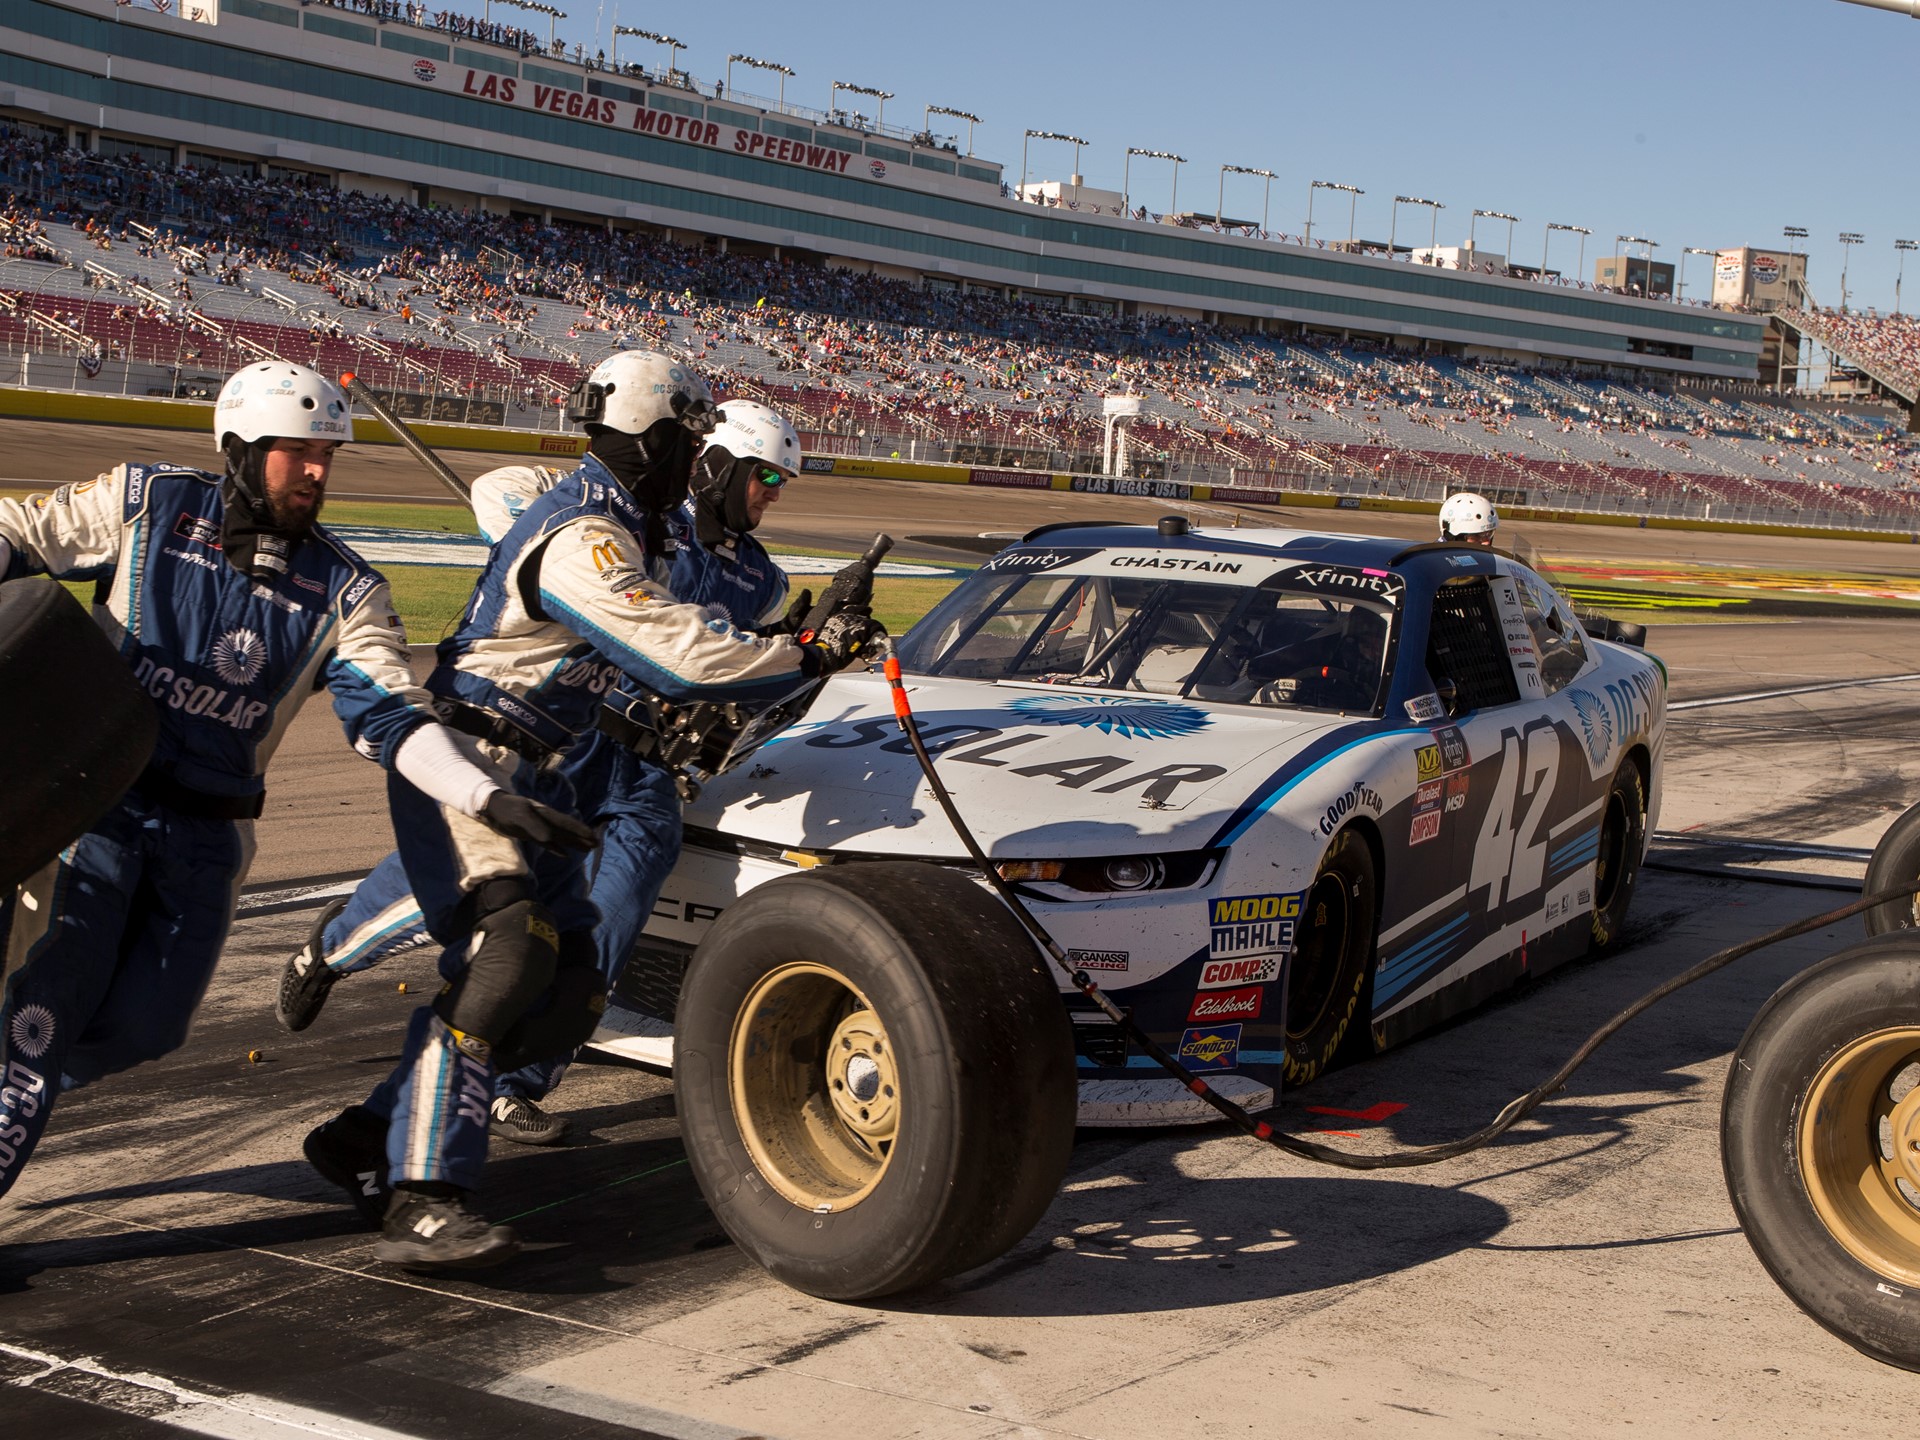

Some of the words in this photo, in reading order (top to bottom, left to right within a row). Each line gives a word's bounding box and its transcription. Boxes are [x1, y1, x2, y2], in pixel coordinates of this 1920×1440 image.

[463, 69, 517, 102] LAS
[534, 84, 617, 124] VEGAS
[633, 107, 720, 147] MOTOR
[734, 129, 851, 173] SPEEDWAY
[653, 384, 665, 394] DC
[310, 421, 324, 432] DC
[324, 421, 347, 434] SOLAR
[733, 421, 756, 437] SOLAR
[541, 437, 578, 453] PIRELLI
[811, 435, 829, 453] LAS
[831, 437, 860, 456] VEGAS
[806, 458, 834, 471] NASCAR
[131, 467, 144, 504] sparco
[974, 471, 1048, 486] STRATOSPHEREHOTEL.COM
[1086, 478, 1110, 493] LAS
[1113, 479, 1150, 496] VEGAS
[1155, 483, 1177, 498] USA
[163, 546, 219, 572] GOODYEAR
[983, 553, 1072, 571] xfinity
[1110, 555, 1243, 574] CHASTAIN
[1295, 568, 1404, 597] xfinity
[172, 678, 268, 730] SOLAR
[1603, 679, 1640, 746] DC
[805, 719, 1228, 802] SOLAR
[1418, 783, 1440, 804] Duralast
[1445, 793, 1465, 813] MSD
[1320, 782, 1383, 836] GOODYEAR
[1468, 722, 1561, 913] 42
[1411, 813, 1440, 843] SIMPSON
[1214, 896, 1300, 923] MOOG
[1211, 922, 1293, 952] MAHLE
[1080, 952, 1127, 963] GANASSI
[1204, 960, 1262, 984] COMP
[1242, 972, 1269, 983] CAMS
[1194, 994, 1255, 1017] Edelbrock
[1183, 1039, 1236, 1056] SUNOCO
[1, 1060, 44, 1118] DC
